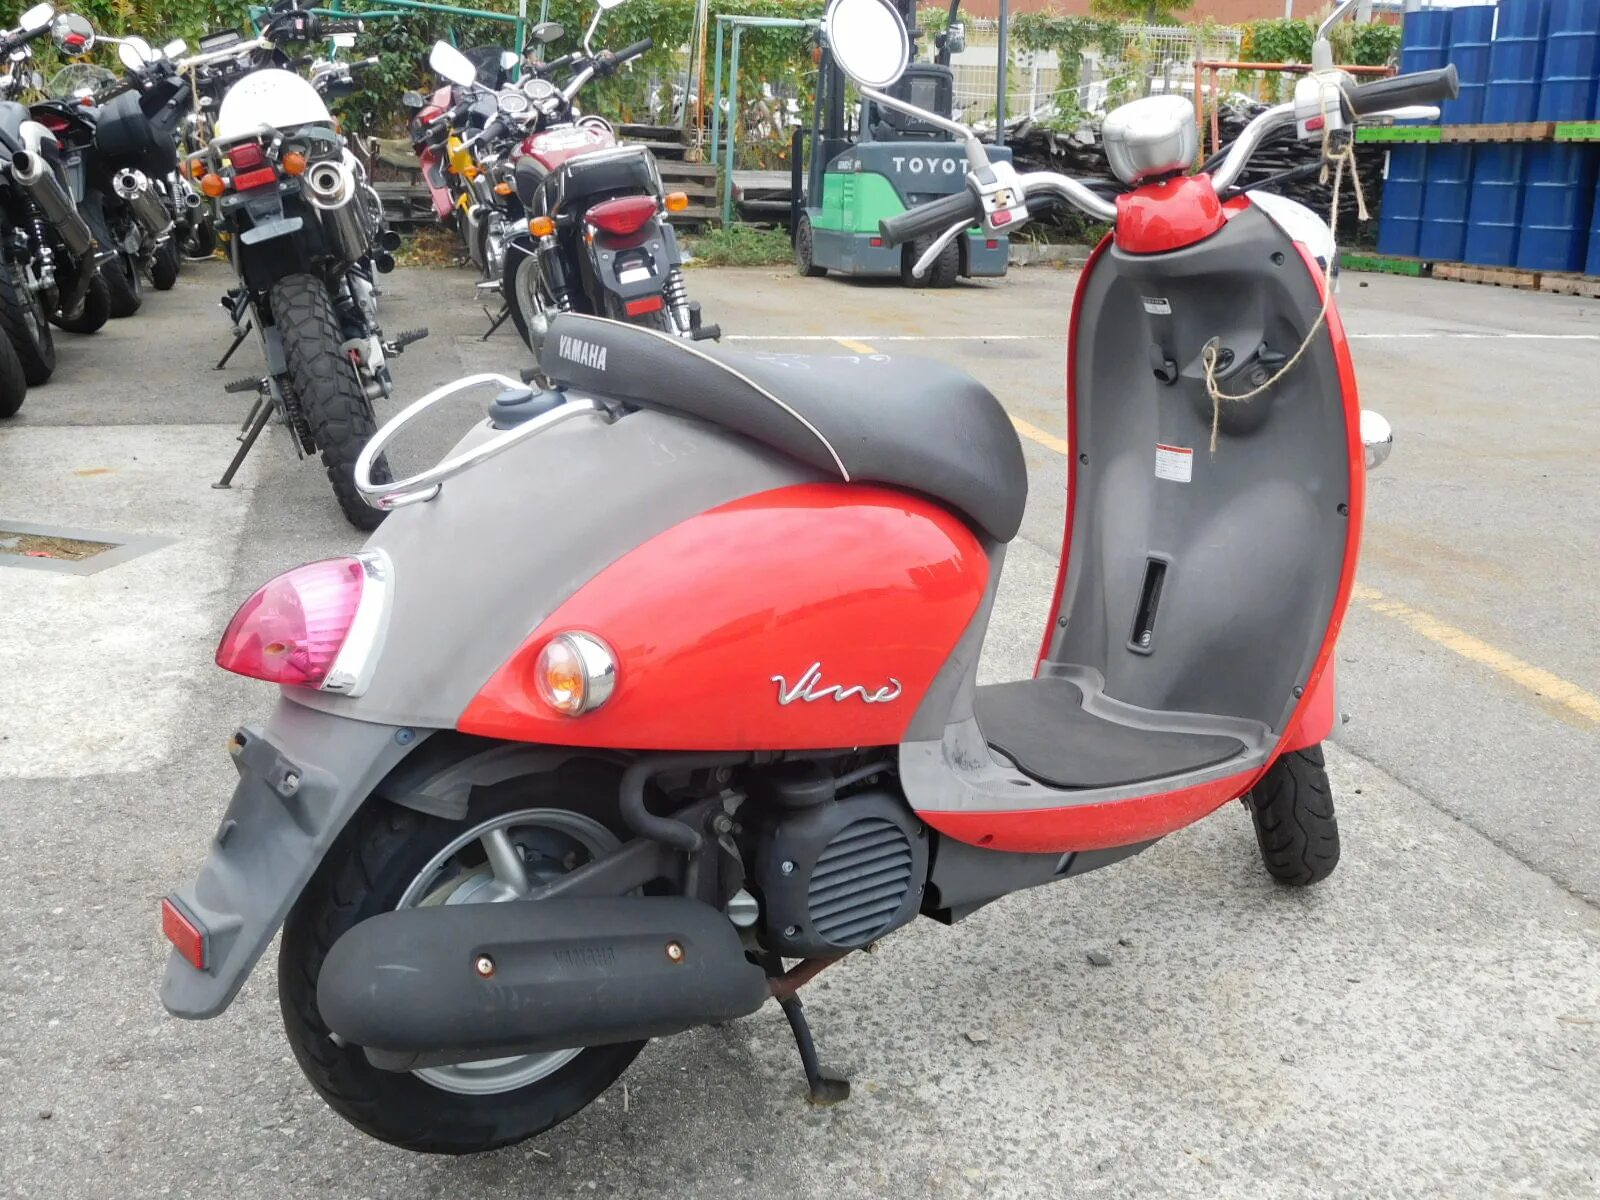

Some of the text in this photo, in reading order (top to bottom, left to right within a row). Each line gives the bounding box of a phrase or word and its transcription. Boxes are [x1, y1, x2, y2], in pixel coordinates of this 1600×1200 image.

[892, 156, 969, 174] TOYOT
[559, 334, 608, 371] YAMAHA
[770, 661, 902, 706] Vino
